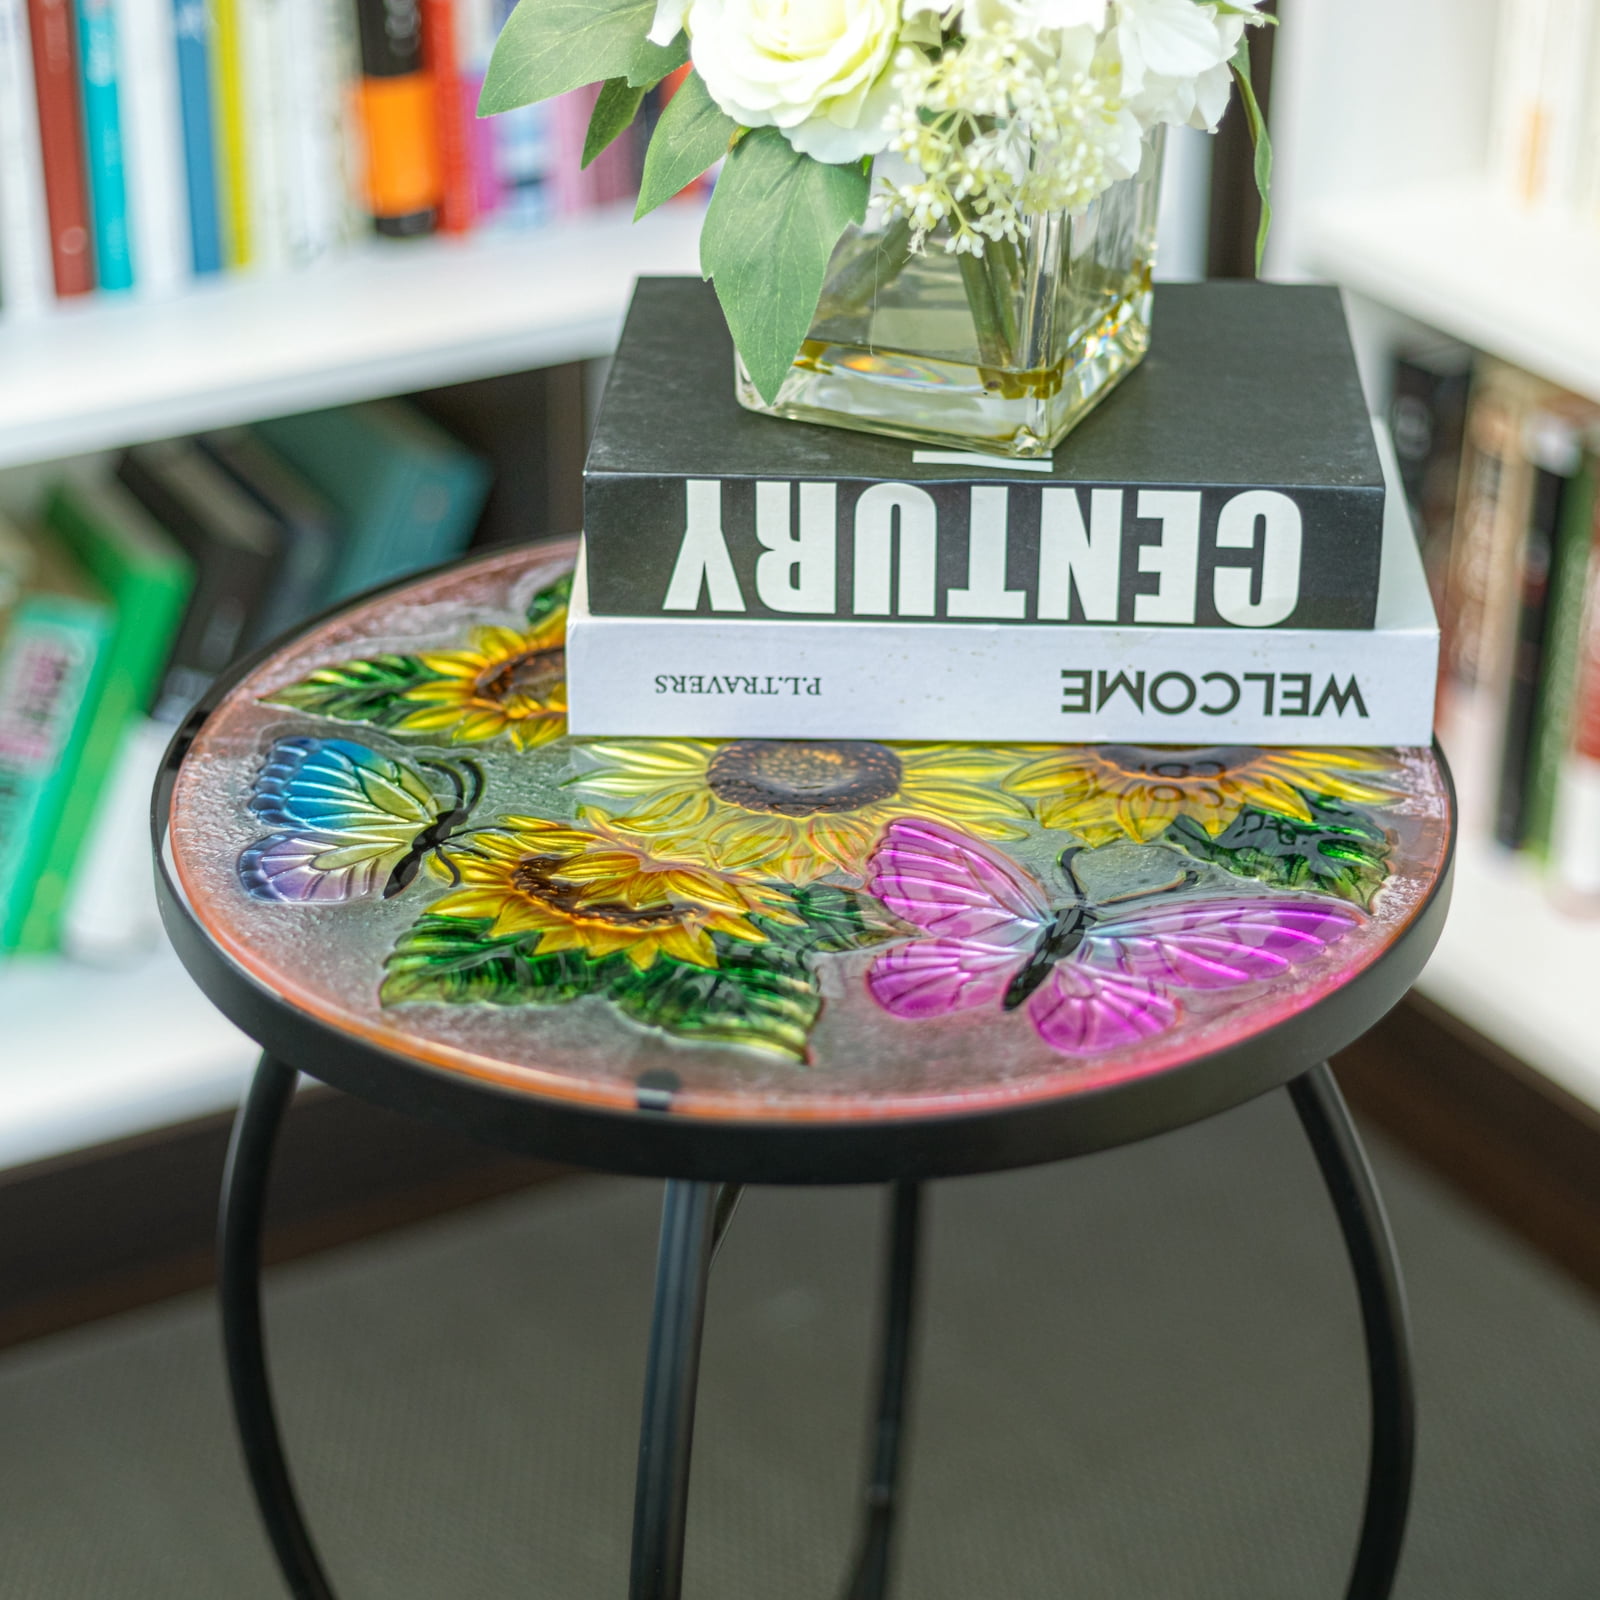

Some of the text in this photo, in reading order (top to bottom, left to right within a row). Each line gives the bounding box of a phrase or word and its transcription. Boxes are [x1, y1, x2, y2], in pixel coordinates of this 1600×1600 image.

[663, 479, 1304, 628] CENTURY
[655, 674, 821, 696] P.L.TRAVERS
[1061, 669, 1369, 718] WELCOME
